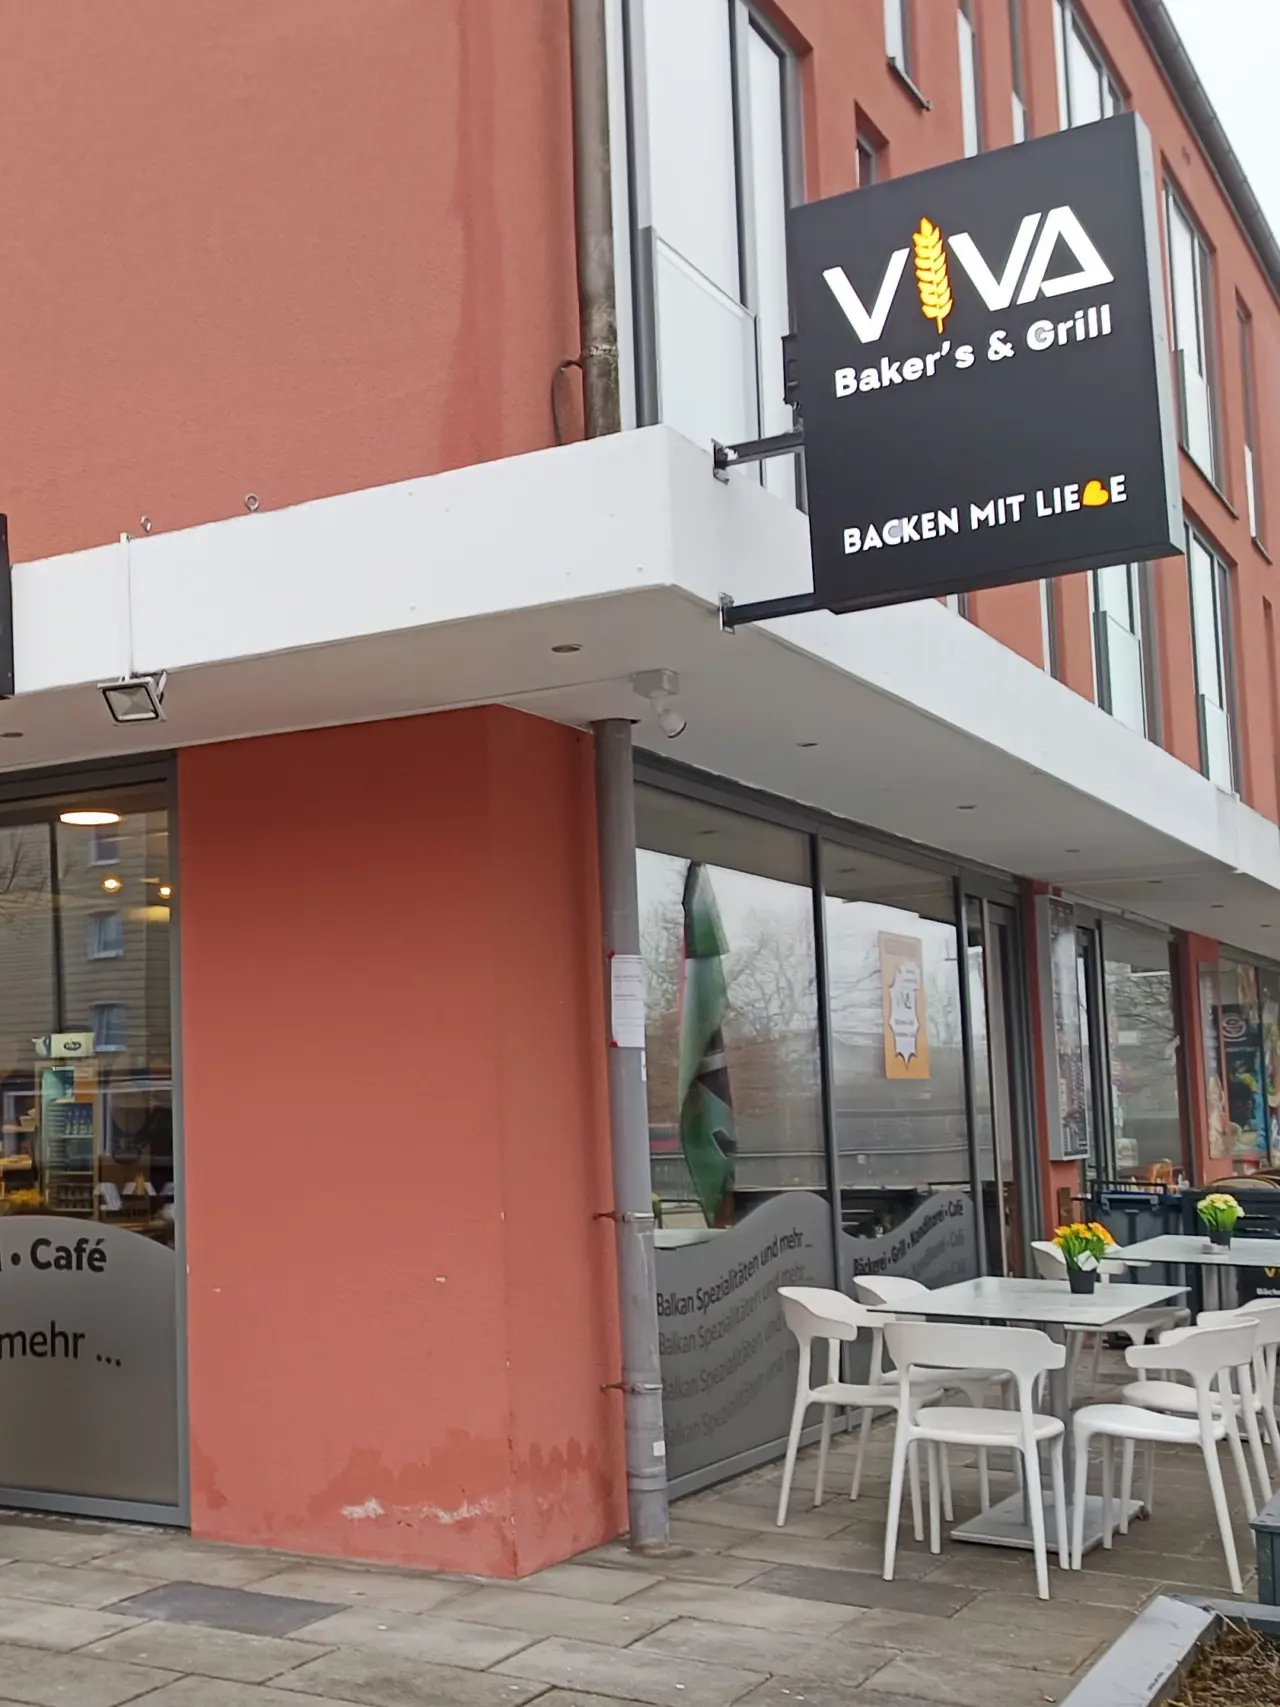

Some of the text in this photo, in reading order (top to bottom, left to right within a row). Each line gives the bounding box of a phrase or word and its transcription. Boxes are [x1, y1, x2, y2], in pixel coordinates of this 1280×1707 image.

[822, 205, 1114, 344] VIVA
[834, 304, 1112, 398] Baker's & Grill
[843, 507, 959, 554] BACKEN
[970, 494, 1025, 530] MIT
[30, 1237, 107, 1273] Café
[657, 1291, 695, 1318] Balkan
[695, 1256, 760, 1316] Spezialitäten
[760, 1234, 779, 1266] und
[779, 1226, 804, 1252] mehr
